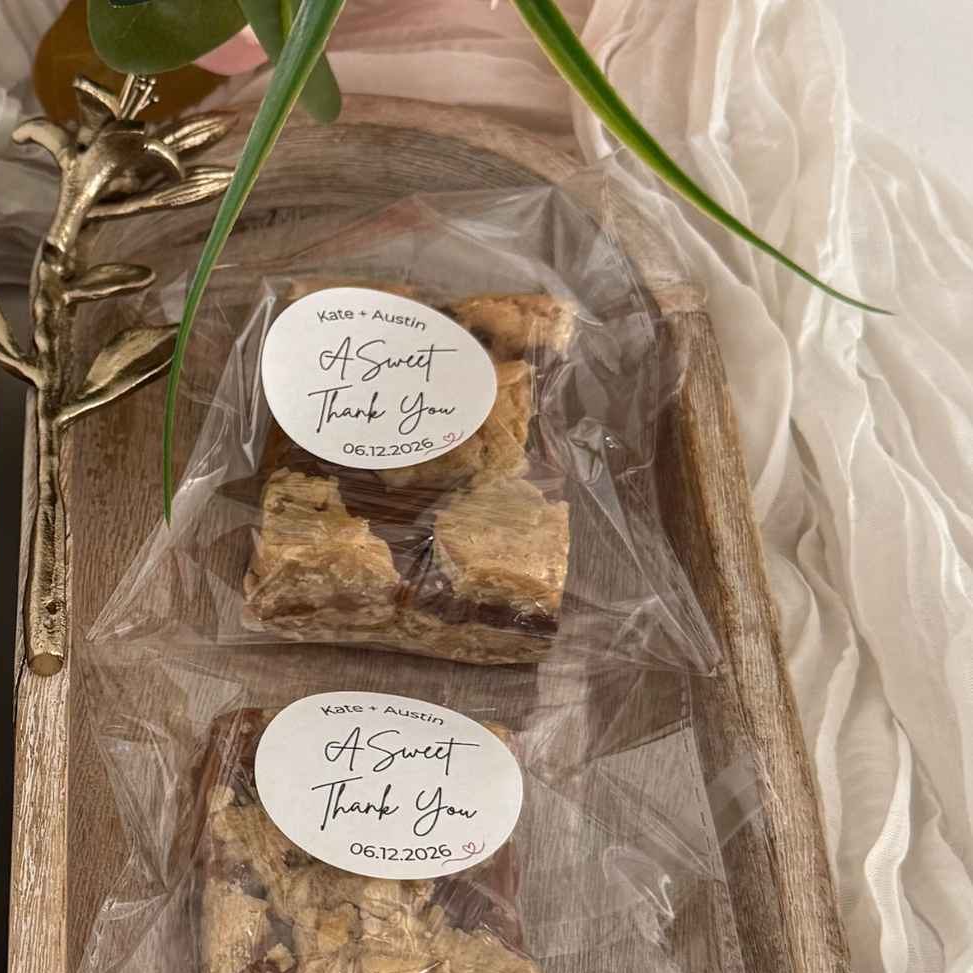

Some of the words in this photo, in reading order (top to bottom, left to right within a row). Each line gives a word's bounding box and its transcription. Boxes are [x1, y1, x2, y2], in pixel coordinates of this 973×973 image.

[316, 309, 355, 324] Kate
[371, 309, 426, 331] Austin
[319, 336, 354, 380] A
[356, 339, 457, 382] Sweet
[308, 385, 386, 433] Thank
[398, 392, 456, 435] You
[342, 438, 434, 457] 06.12.2026
[320, 704, 364, 716] Kate
[383, 706, 444, 726] Austin
[324, 727, 365, 772] A
[367, 730, 480, 776] Sweet
[311, 776, 400, 831] Thank
[412, 786, 478, 837] You
[350, 842, 452, 862] 06.12.2026
